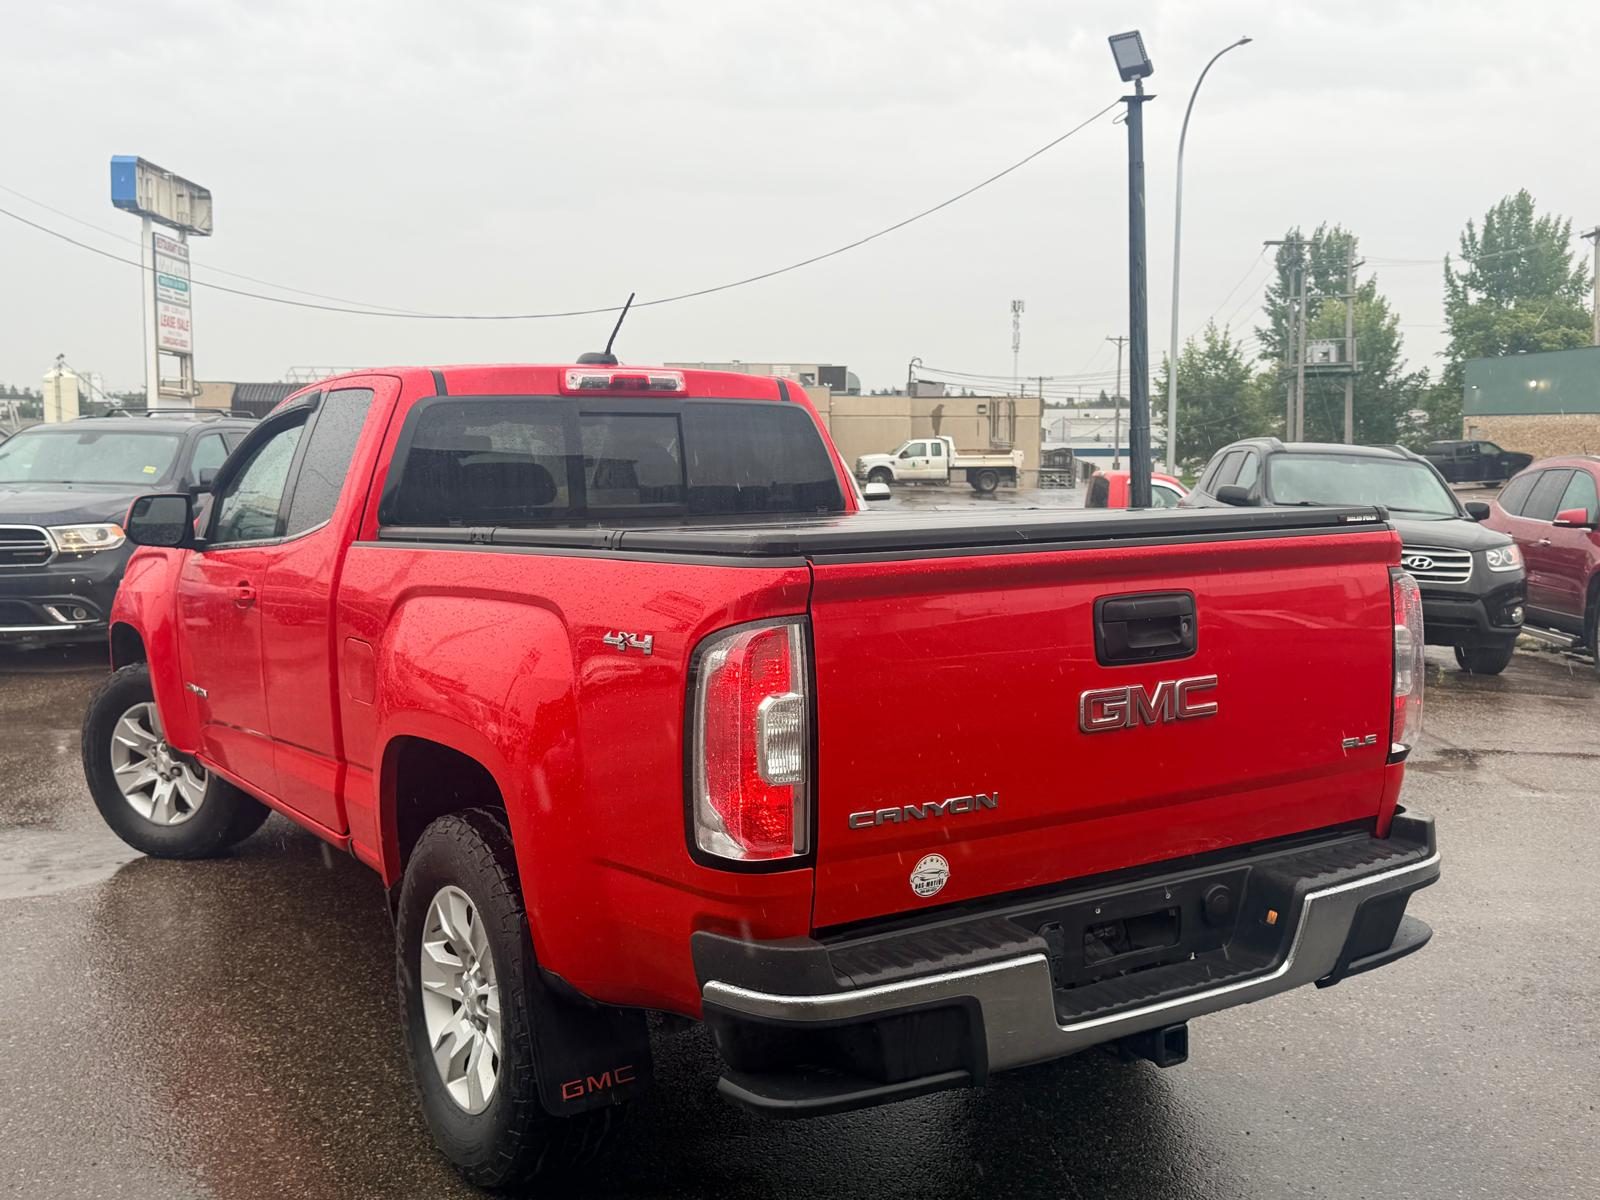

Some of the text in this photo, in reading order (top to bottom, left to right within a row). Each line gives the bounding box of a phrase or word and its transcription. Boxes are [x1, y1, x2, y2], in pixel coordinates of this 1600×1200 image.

[160, 314, 176, 328] LEASE
[1080, 674, 1218, 733] GMC
[849, 791, 999, 830] CANYON
[562, 1065, 636, 1100] GMC
